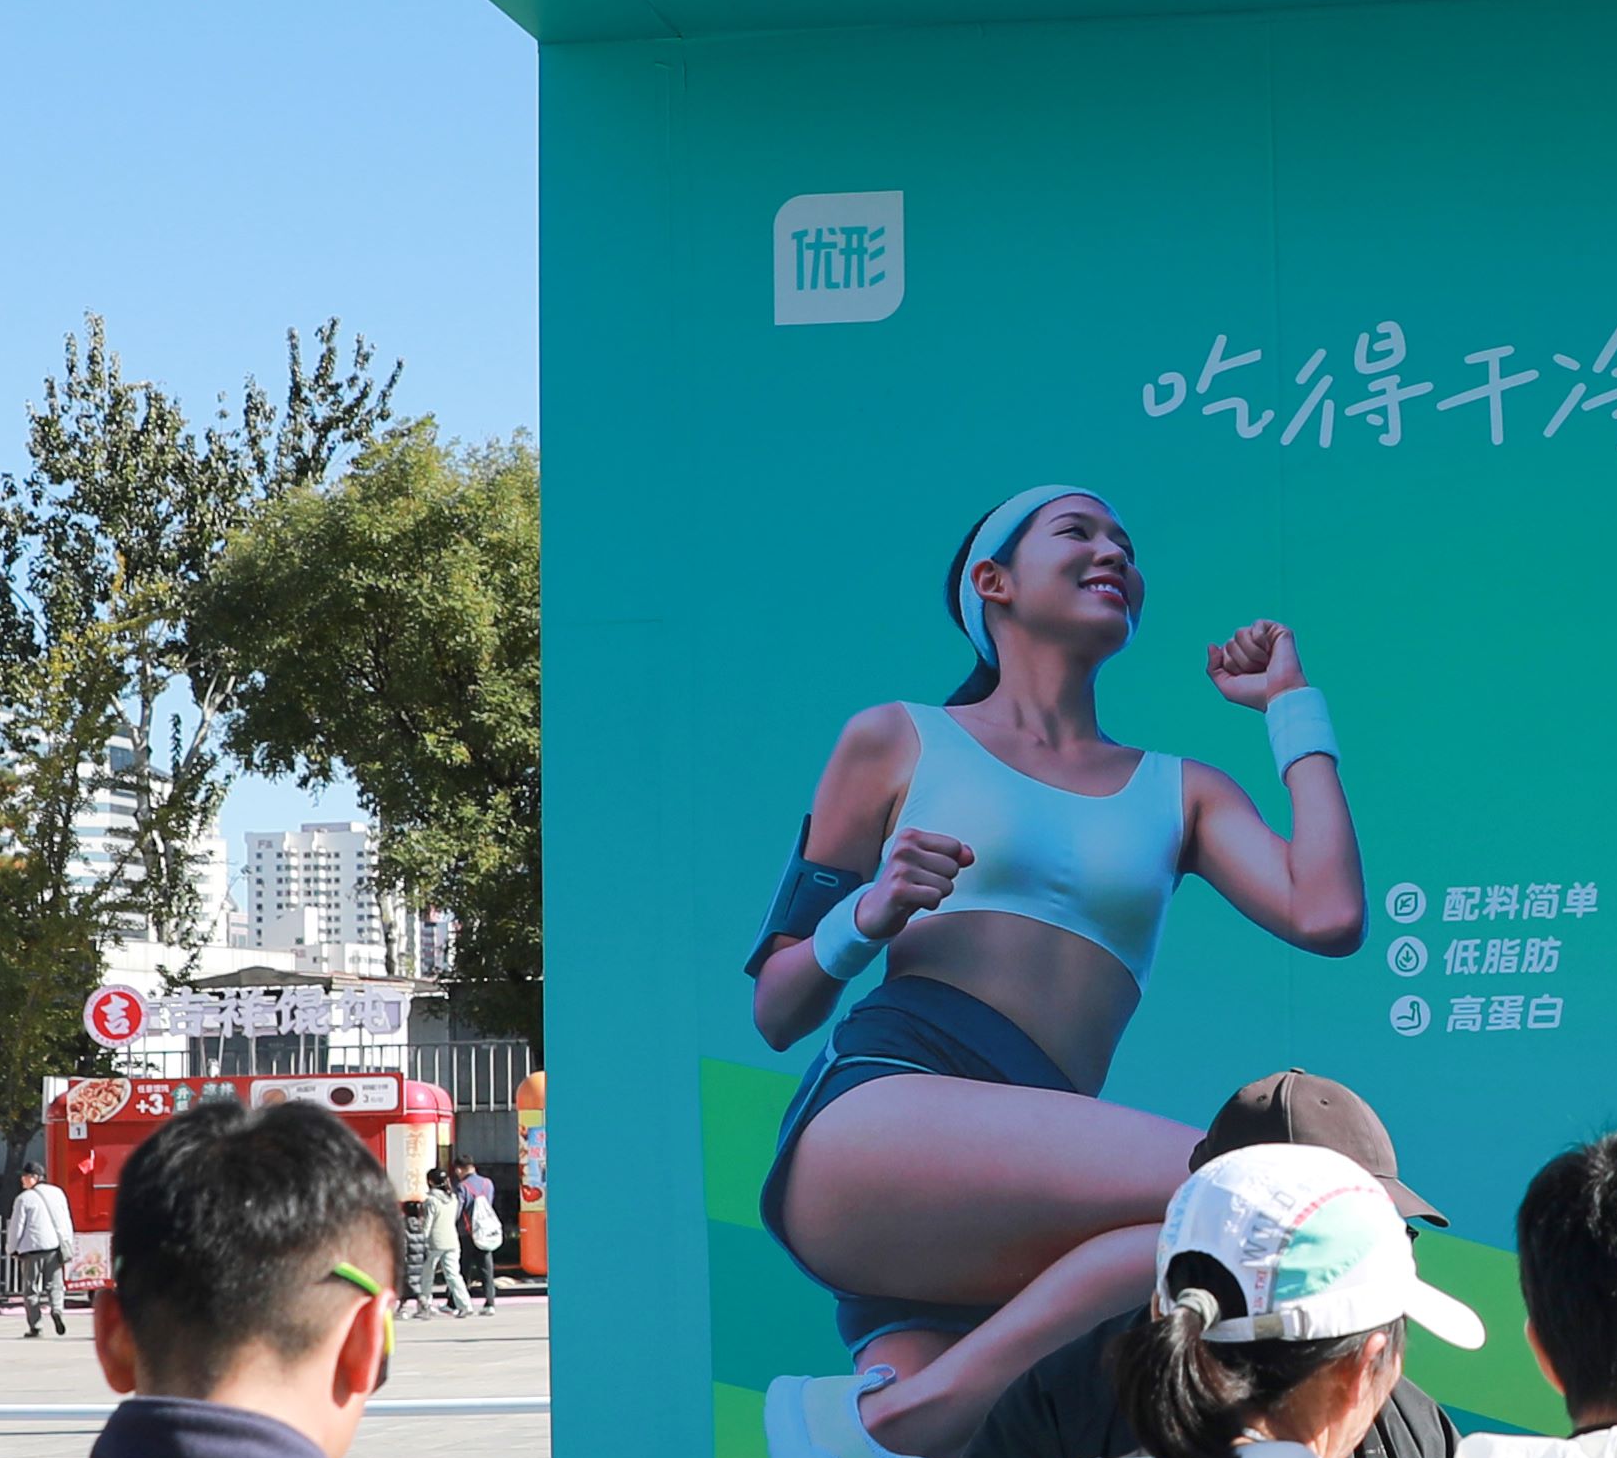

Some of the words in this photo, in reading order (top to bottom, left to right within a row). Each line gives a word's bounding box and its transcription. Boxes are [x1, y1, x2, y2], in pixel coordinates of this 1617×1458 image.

[791, 226, 885, 290] 优形
[1442, 882, 1598, 921] 配料简单
[1443, 936, 1562, 975] 低脂肪
[168, 983, 387, 1039] 吉祥馄饨
[1446, 994, 1564, 1032] 高蛋白
